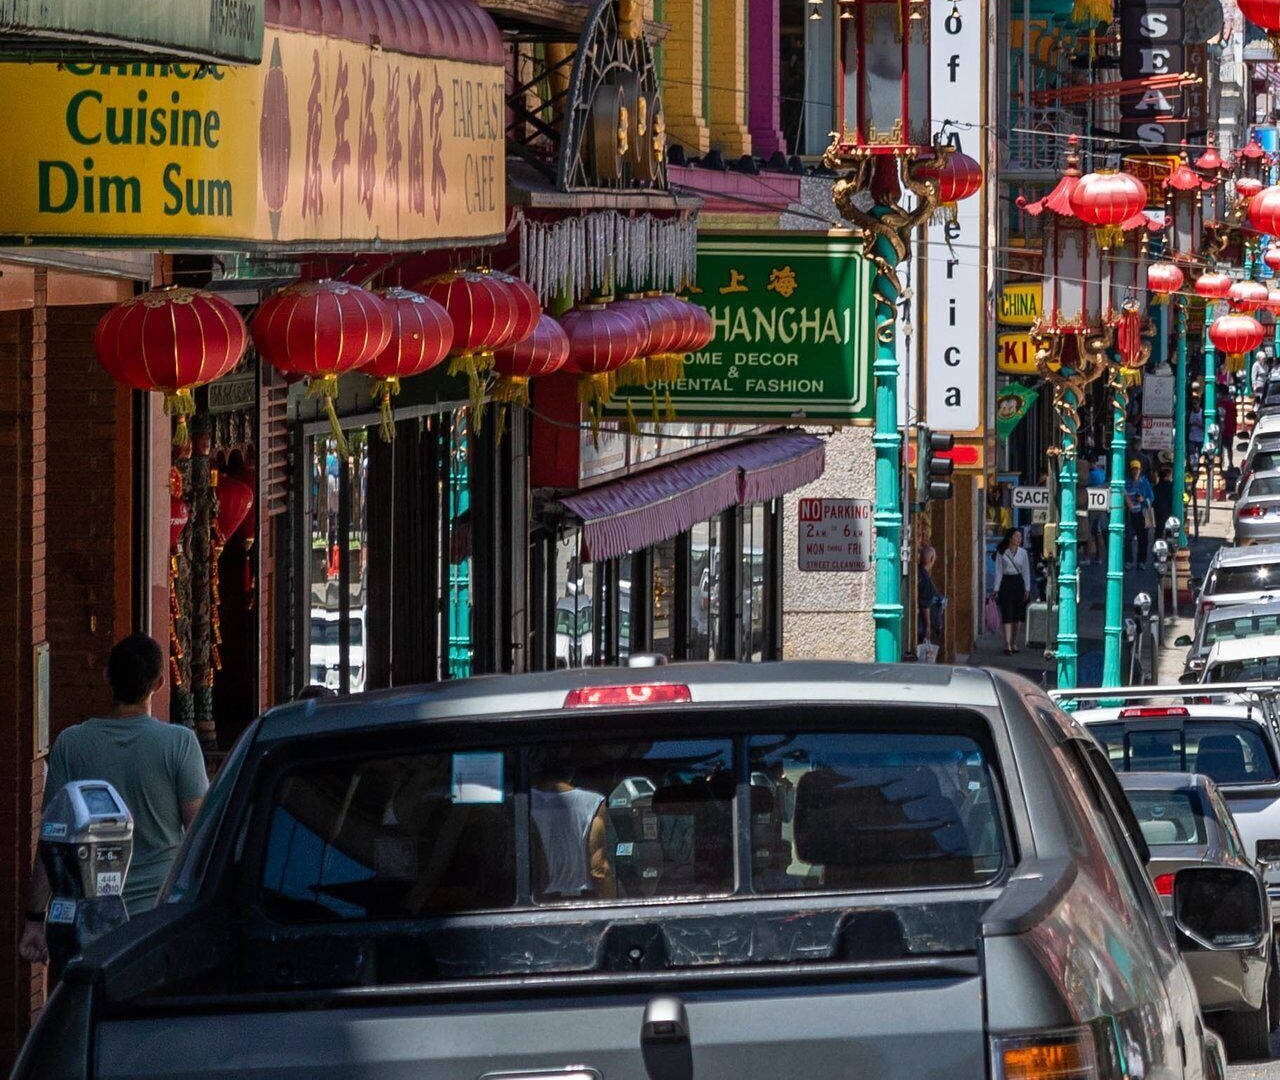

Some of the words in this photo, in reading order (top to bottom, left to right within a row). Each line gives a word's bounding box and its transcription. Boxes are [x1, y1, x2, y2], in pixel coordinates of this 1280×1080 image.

[942, 12, 964, 83] of
[1134, 13, 1173, 149] SEAS
[65, 90, 221, 149] Cuisine
[452, 79, 476, 142] FAR
[477, 81, 505, 142] EAST
[38, 160, 142, 215] Dim
[163, 162, 233, 217] Sum
[1001, 293, 1037, 317] CHINA
[701, 305, 850, 345] HANGHAI
[682, 352, 723, 366] OME
[734, 353, 799, 366] DECOR
[727, 366, 740, 378] &
[745, 379, 825, 393] FASHION
[801, 499, 822, 520] NO
[824, 504, 870, 520] PARKING
[806, 543, 825, 555] MON
[848, 543, 862, 555] FRI
[806, 560, 830, 570] STREET
[831, 560, 866, 570] CLEANING
